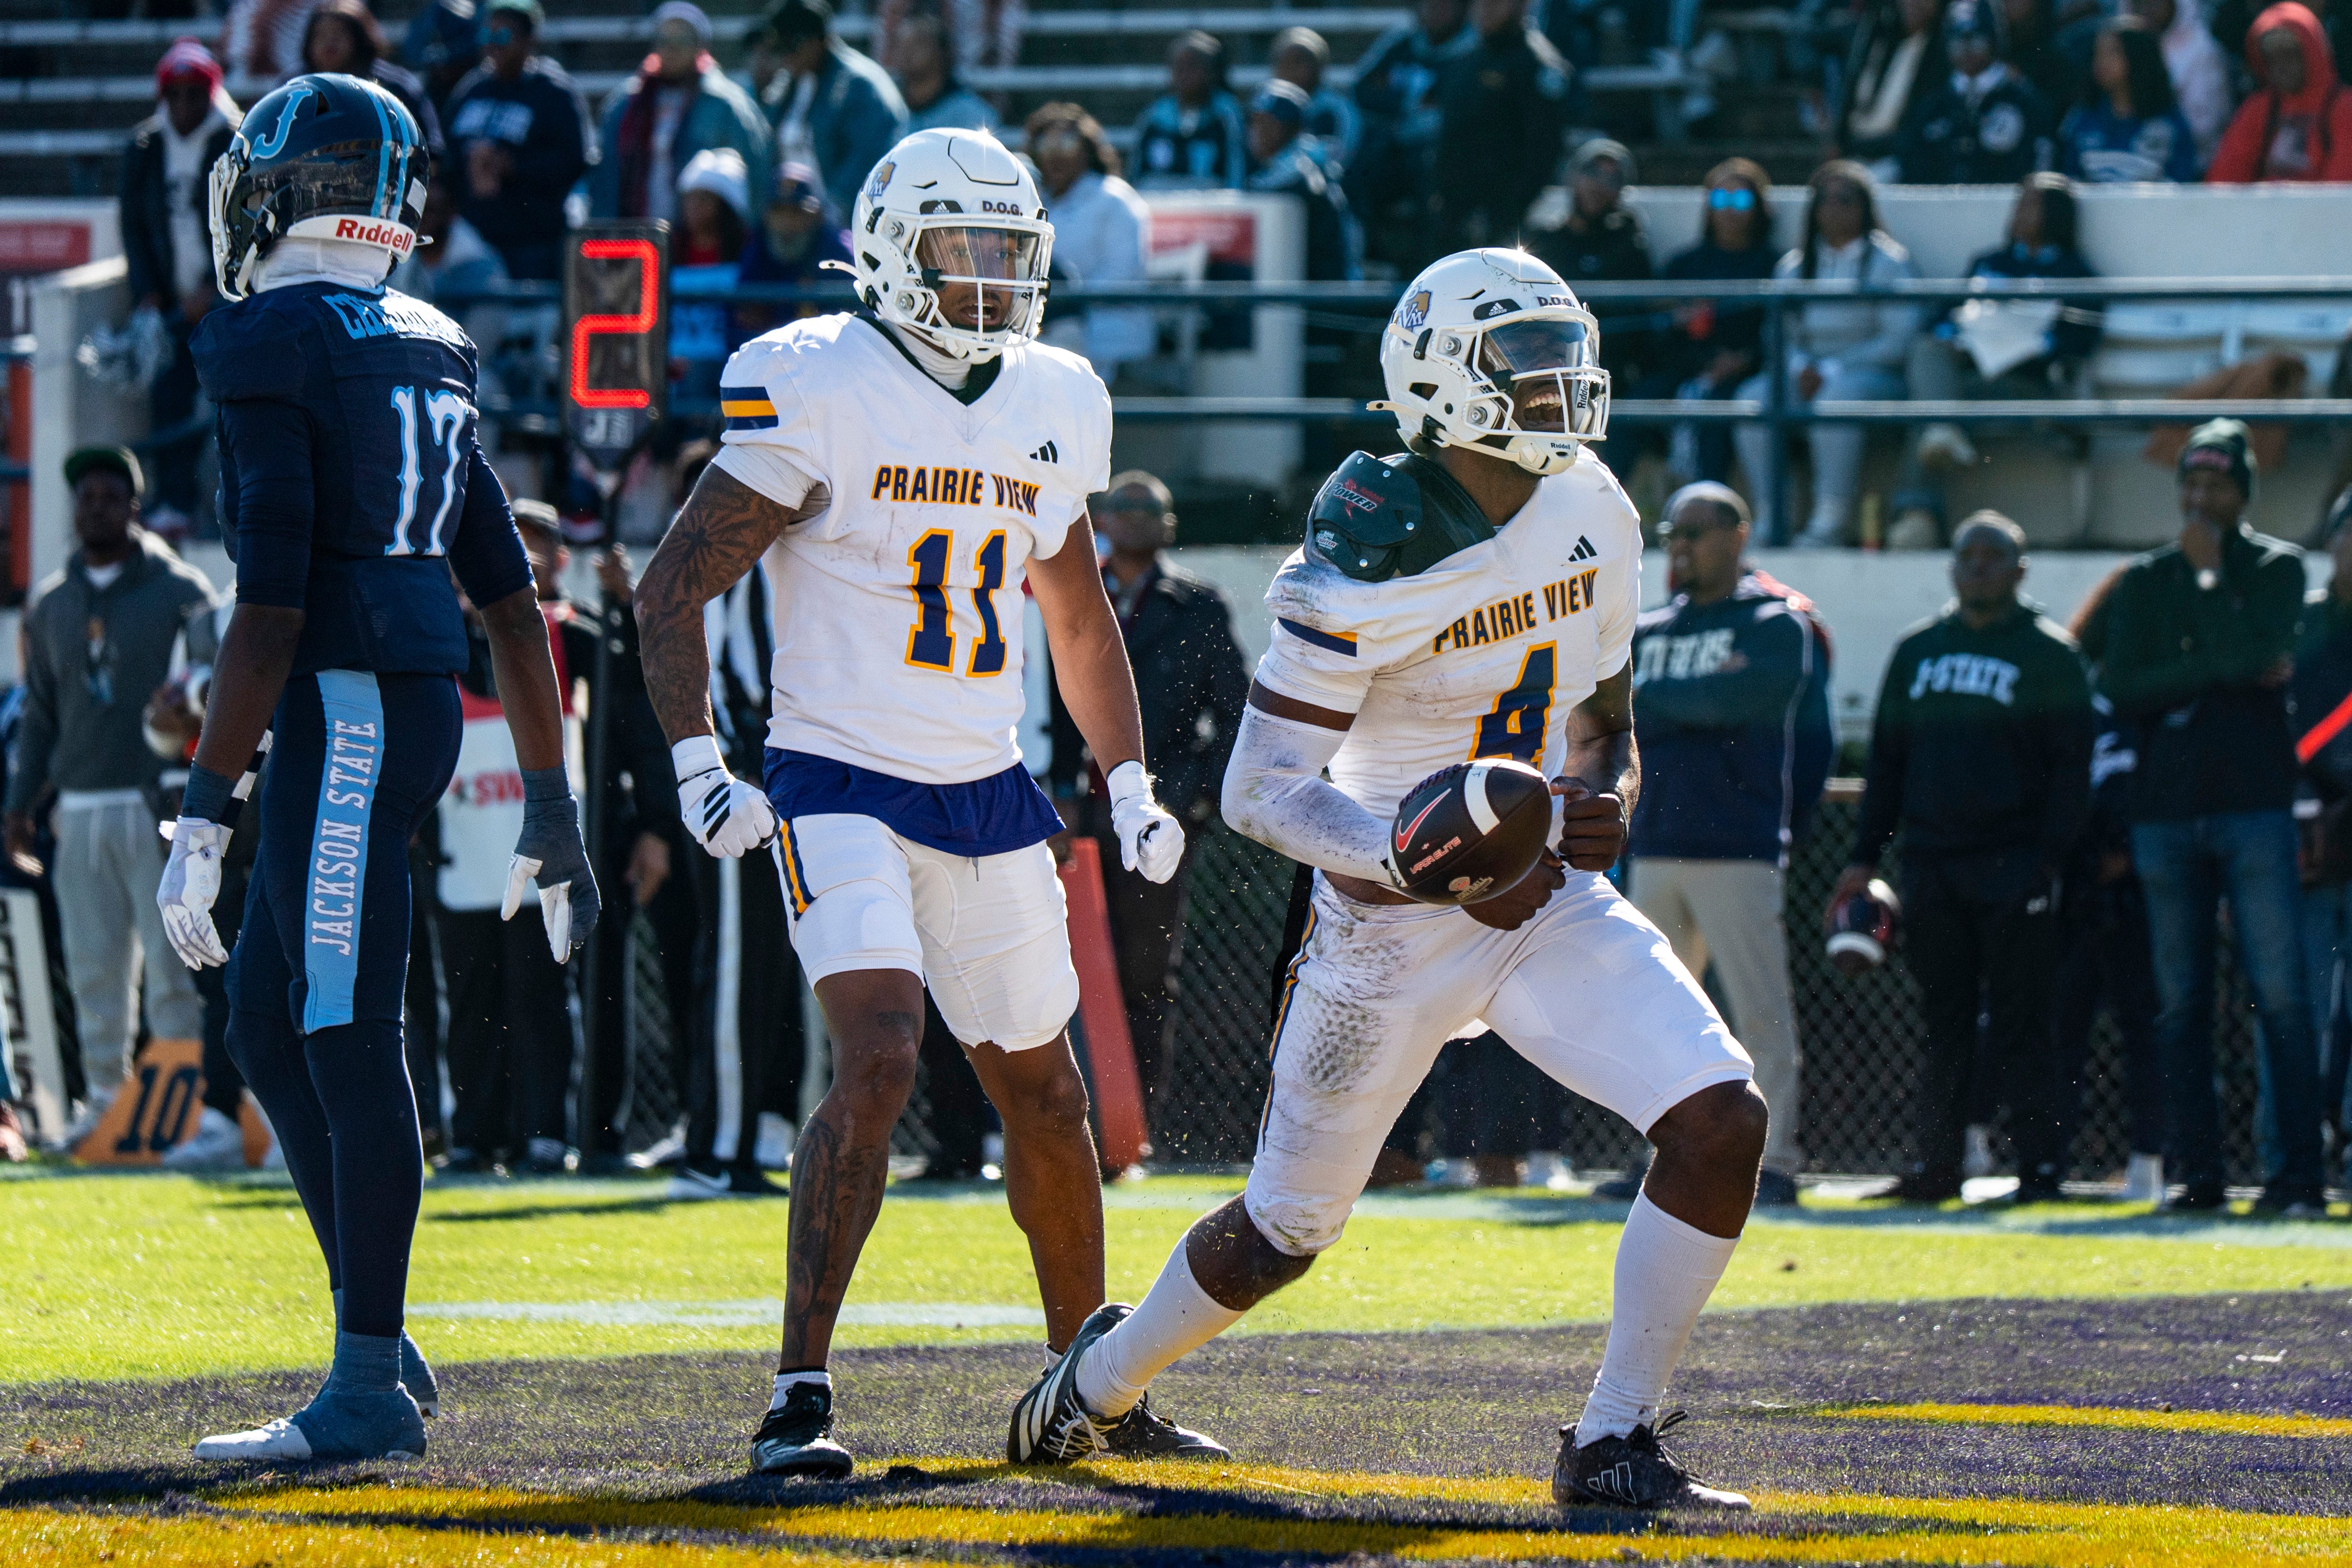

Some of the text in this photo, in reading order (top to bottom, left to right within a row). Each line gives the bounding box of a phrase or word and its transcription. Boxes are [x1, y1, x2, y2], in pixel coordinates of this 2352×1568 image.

[250, 89, 313, 161] J
[335, 219, 413, 252] Riddell
[982, 200, 1023, 216] D.O.G.
[570, 239, 659, 408] 2
[1488, 308, 1507, 316] adidas
[1536, 296, 1575, 308] D.O.G.
[385, 385, 469, 556] 17
[871, 465, 1041, 518] PRAIRIE VIEW
[1333, 482, 1377, 511] POWER
[904, 528, 1007, 678] 11
[1432, 568, 1598, 654] PRAIRIE VIEW
[1467, 639, 1558, 771] 4
[311, 719, 376, 956] JACKSON STATE
[1409, 836, 1461, 875] VAPOR ELITE
[116, 1067, 199, 1151] 10
